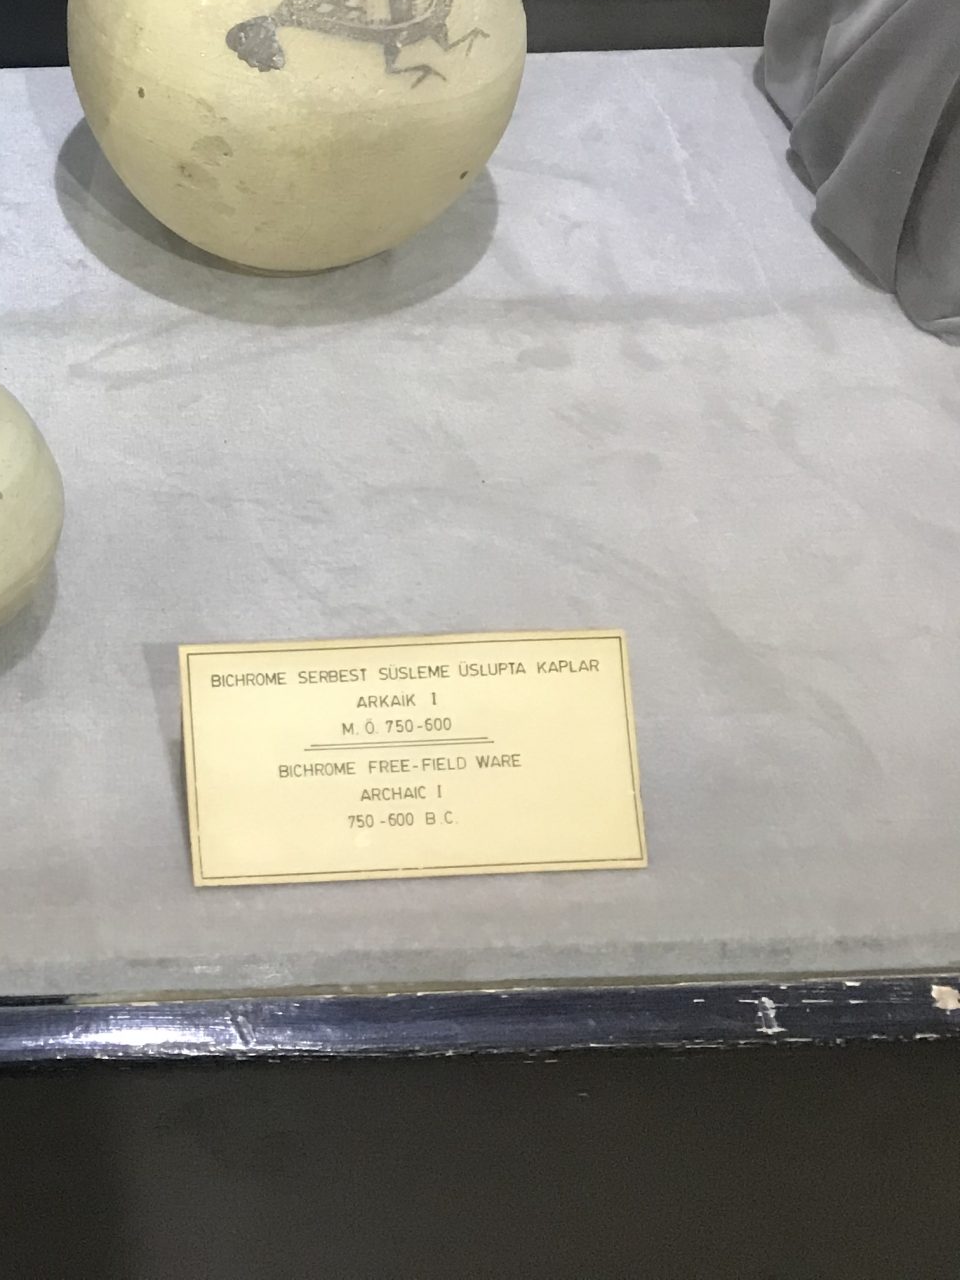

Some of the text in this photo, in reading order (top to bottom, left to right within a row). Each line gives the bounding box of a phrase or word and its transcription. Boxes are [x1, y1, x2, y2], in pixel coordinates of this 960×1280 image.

[211, 659, 600, 688] BICHROME SERBEST SÜSLEME ÜSLUPTA KAPLAR
[278, 754, 522, 778] BICHROME FREE-FIELD WARE
[360, 786, 426, 802] ARCHAIC
